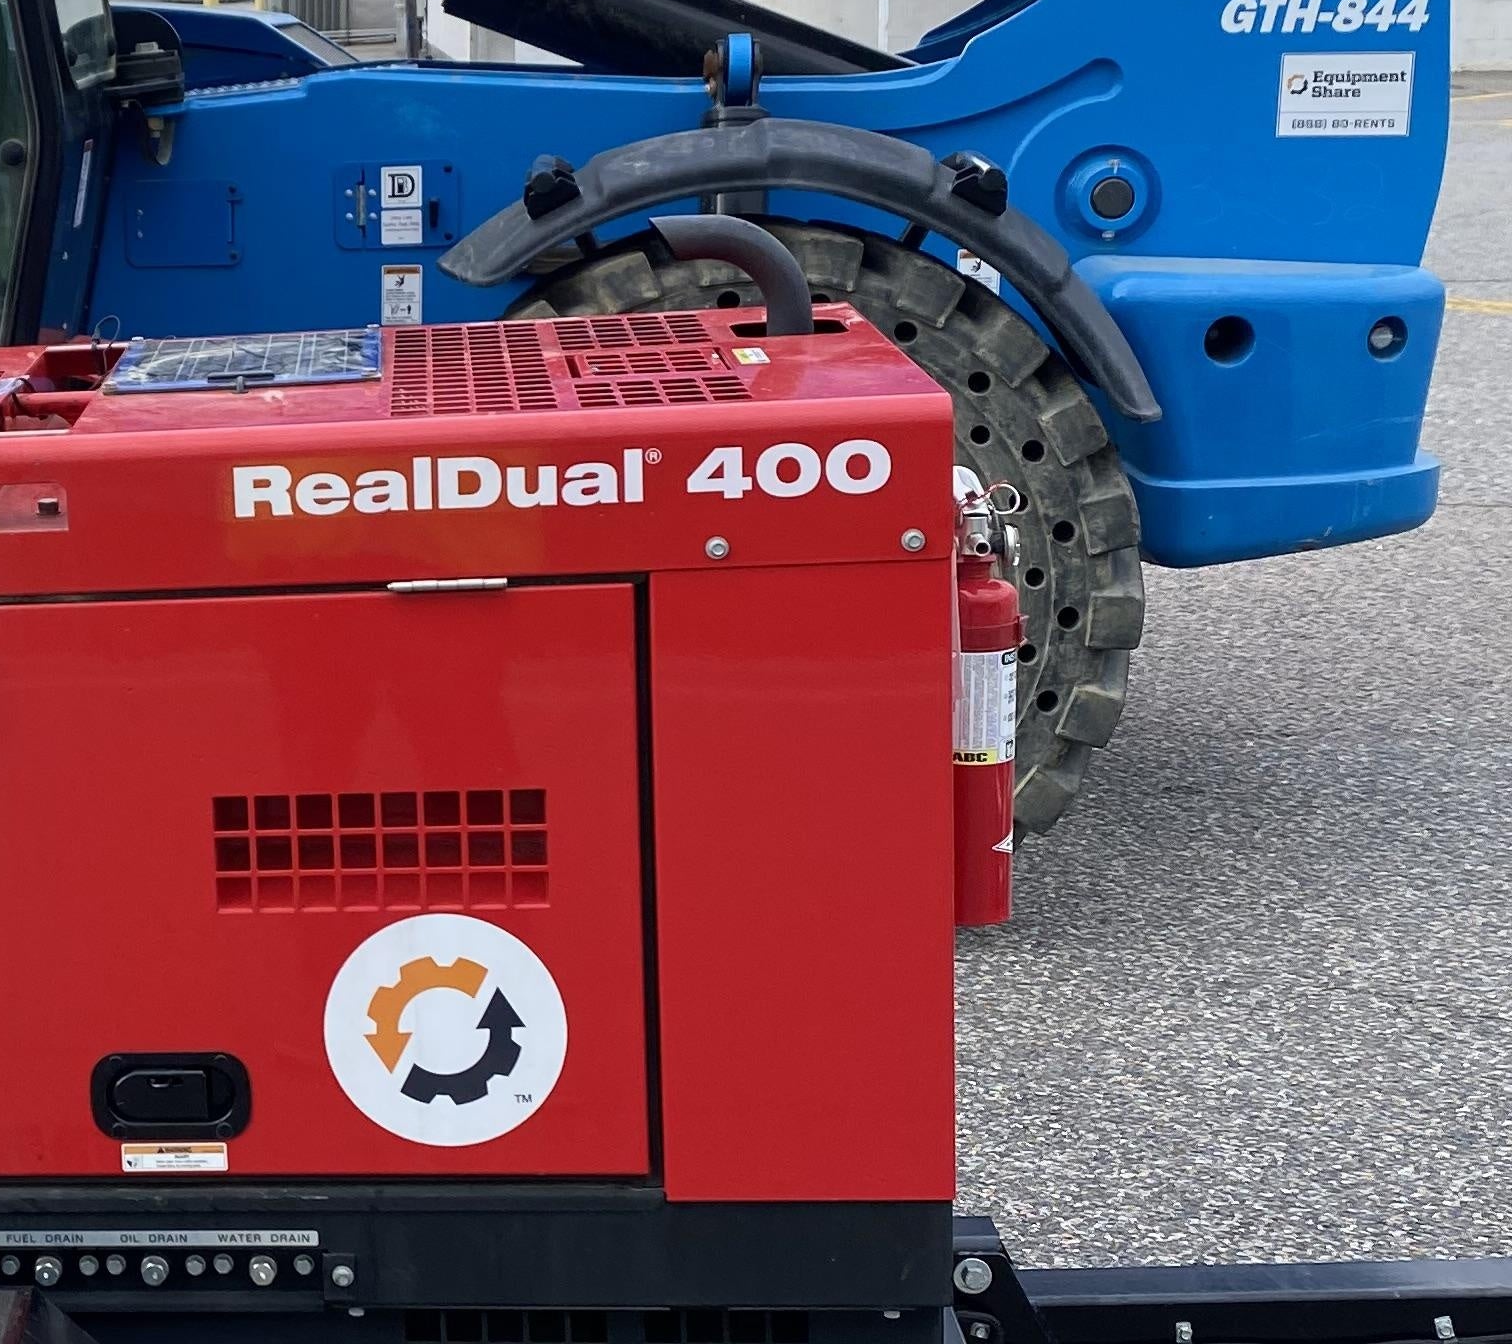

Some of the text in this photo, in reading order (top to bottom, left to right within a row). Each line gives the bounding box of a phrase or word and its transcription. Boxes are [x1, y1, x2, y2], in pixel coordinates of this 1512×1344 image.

[1312, 71, 1407, 85] Equipment
[1311, 86, 1361, 98] Share
[687, 439, 892, 499] 400
[952, 752, 987, 762] ABC
[514, 1093, 533, 1104] TM
[6, 1233, 84, 1244] FUEL DRAIN
[120, 1233, 187, 1244] OIL DRAIN
[217, 1233, 310, 1244] WATER DRAIN
